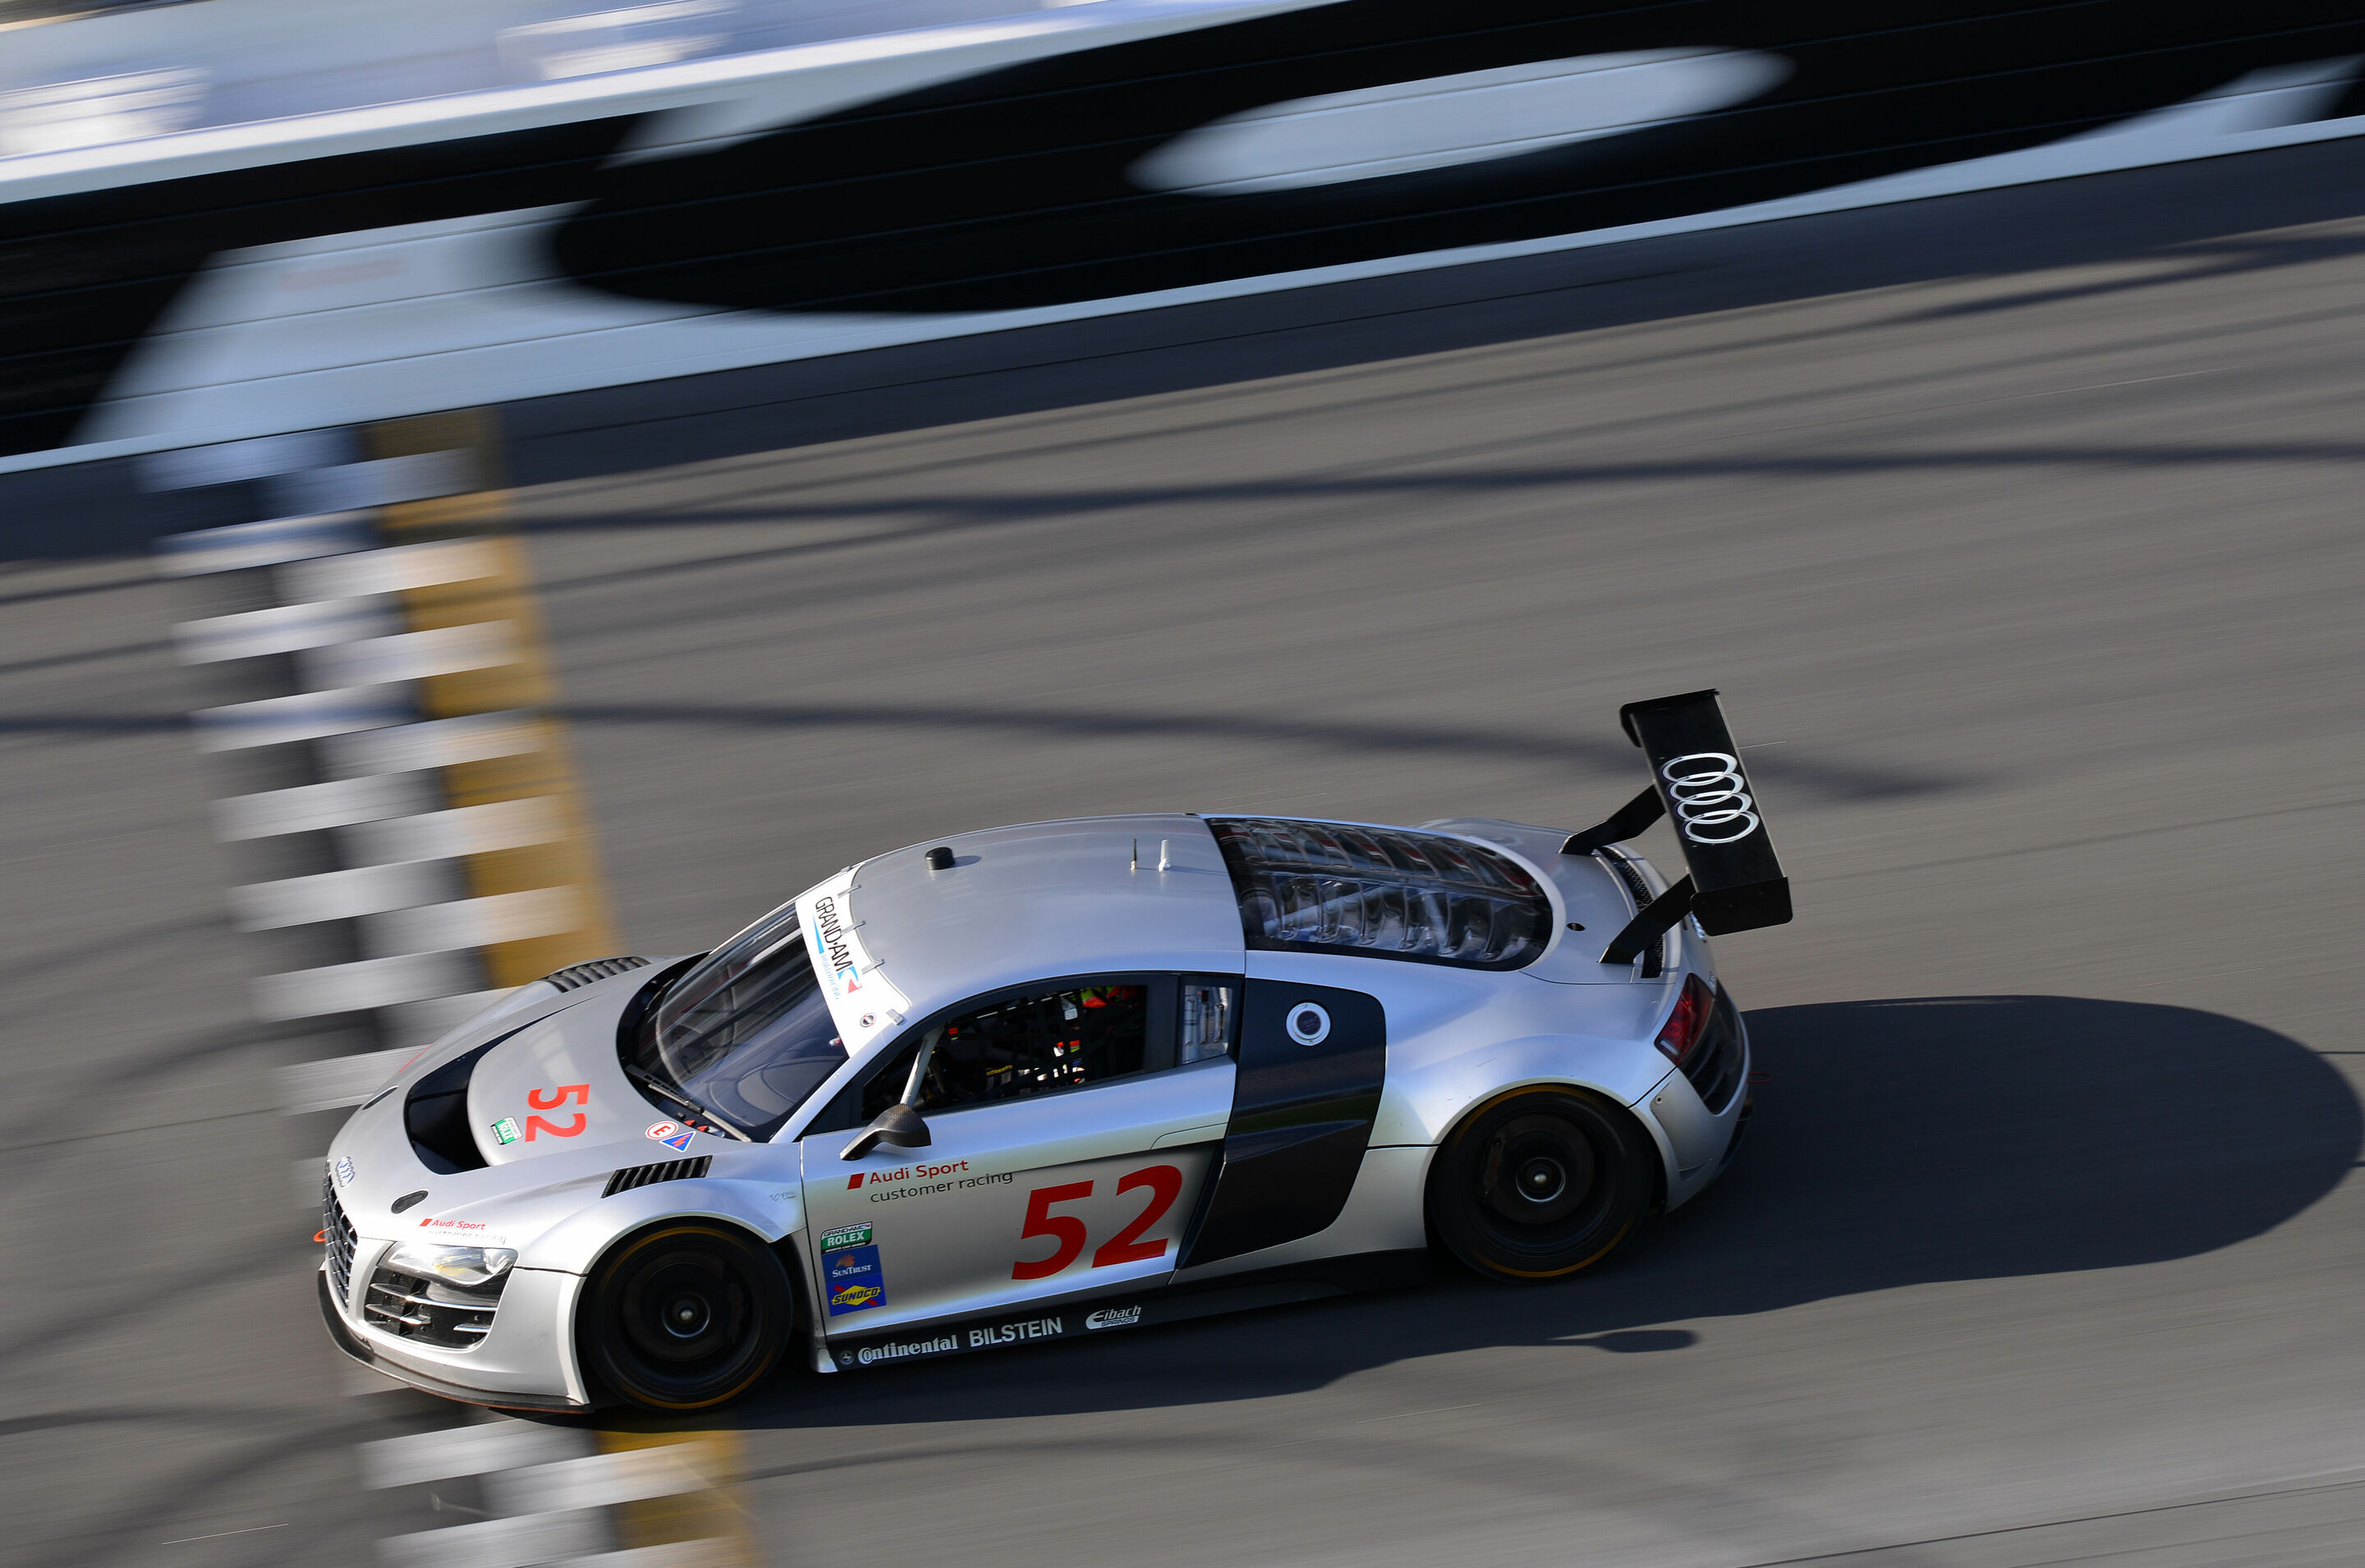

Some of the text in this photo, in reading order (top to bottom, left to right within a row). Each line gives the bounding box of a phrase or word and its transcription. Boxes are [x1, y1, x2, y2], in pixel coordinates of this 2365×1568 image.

[525, 1084, 590, 1142] 52
[654, 1125, 672, 1136] E
[870, 1160, 969, 1185] Audi Sport
[870, 1172, 1013, 1203] customer racing
[431, 1219, 486, 1231] Audi Sport
[1012, 1164, 1182, 1280] 52
[827, 1231, 865, 1247] ROLEX
[833, 1286, 879, 1304] SUNOCO
[1086, 1305, 1141, 1330] Eibach
[969, 1317, 1063, 1348] BILSTEIN
[857, 1334, 958, 1364] Continental
